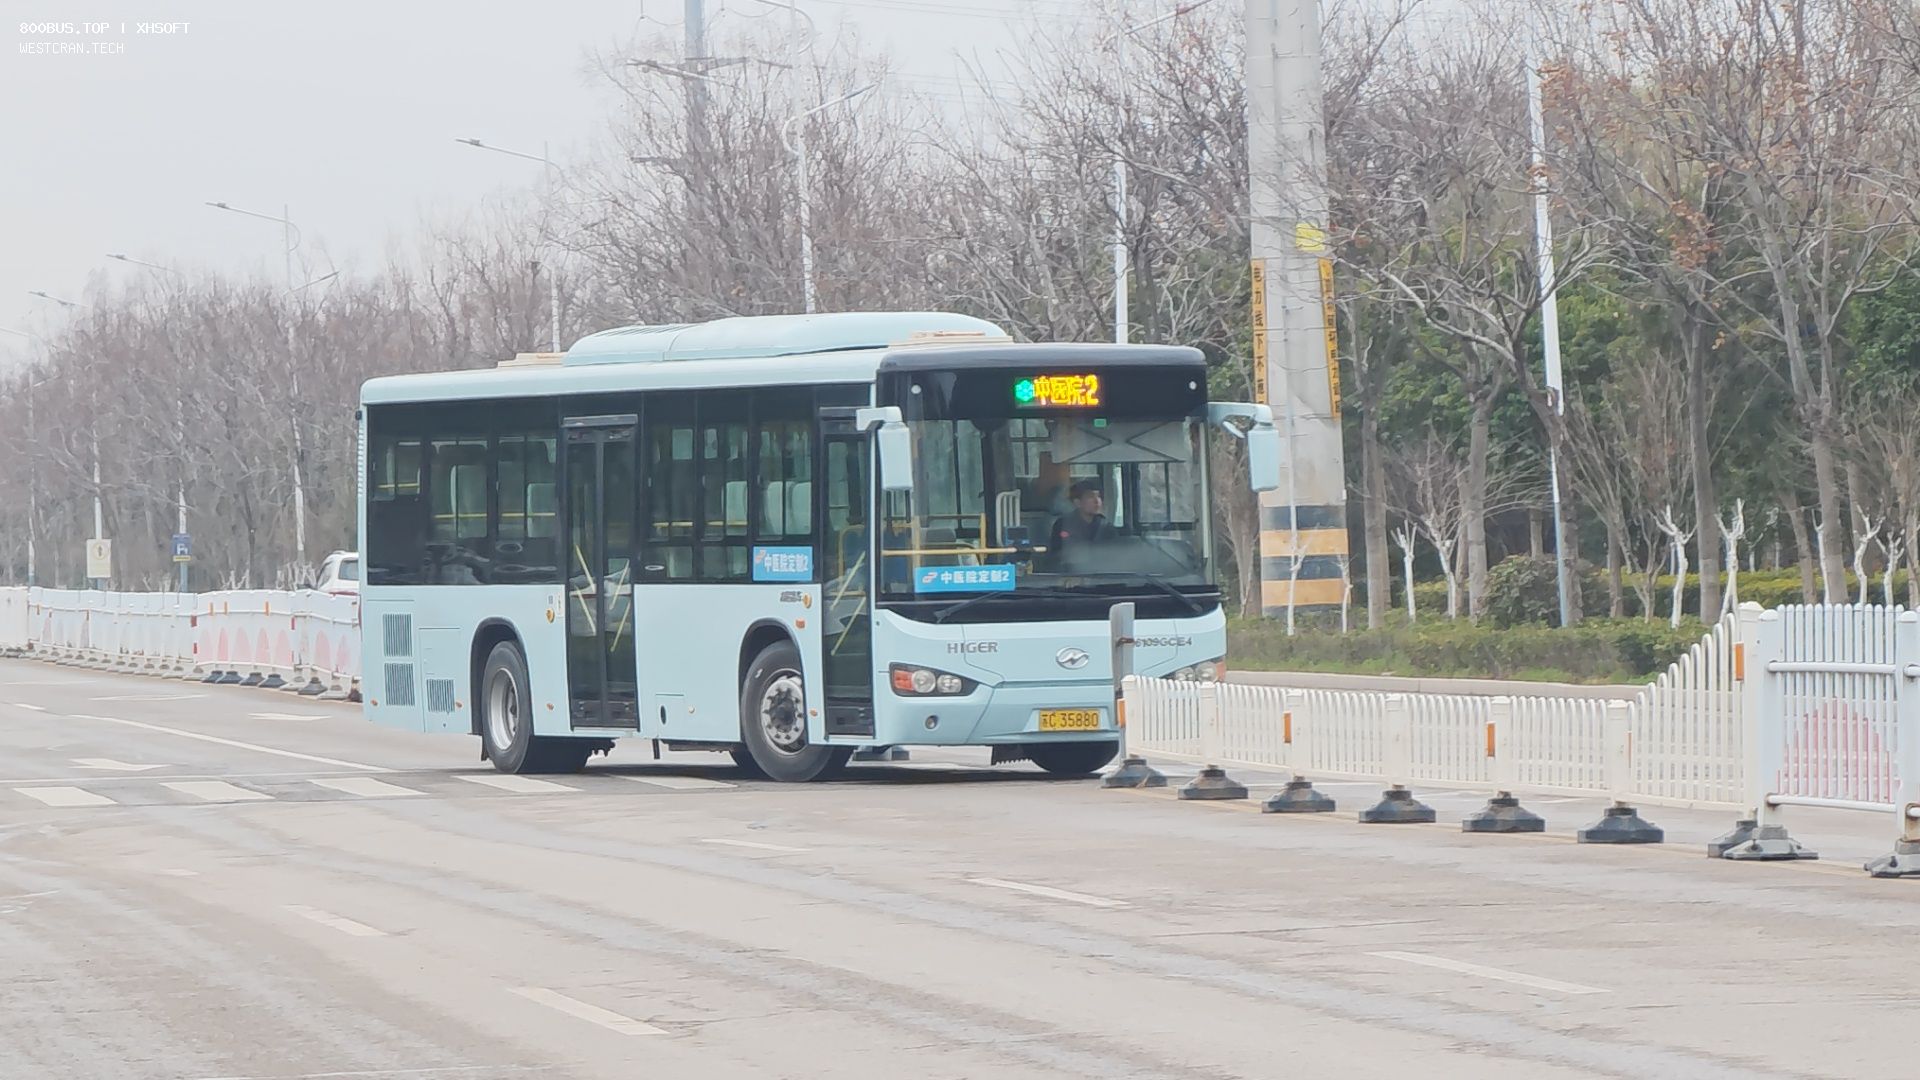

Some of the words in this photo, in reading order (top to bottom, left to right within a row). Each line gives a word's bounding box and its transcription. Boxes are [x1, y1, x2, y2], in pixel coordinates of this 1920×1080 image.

[1253, 266, 1266, 405] 电力线下不
[1033, 374, 1100, 406] 中医院2
[940, 570, 1010, 584] 中医院定制2
[947, 642, 998, 654] HIGER
